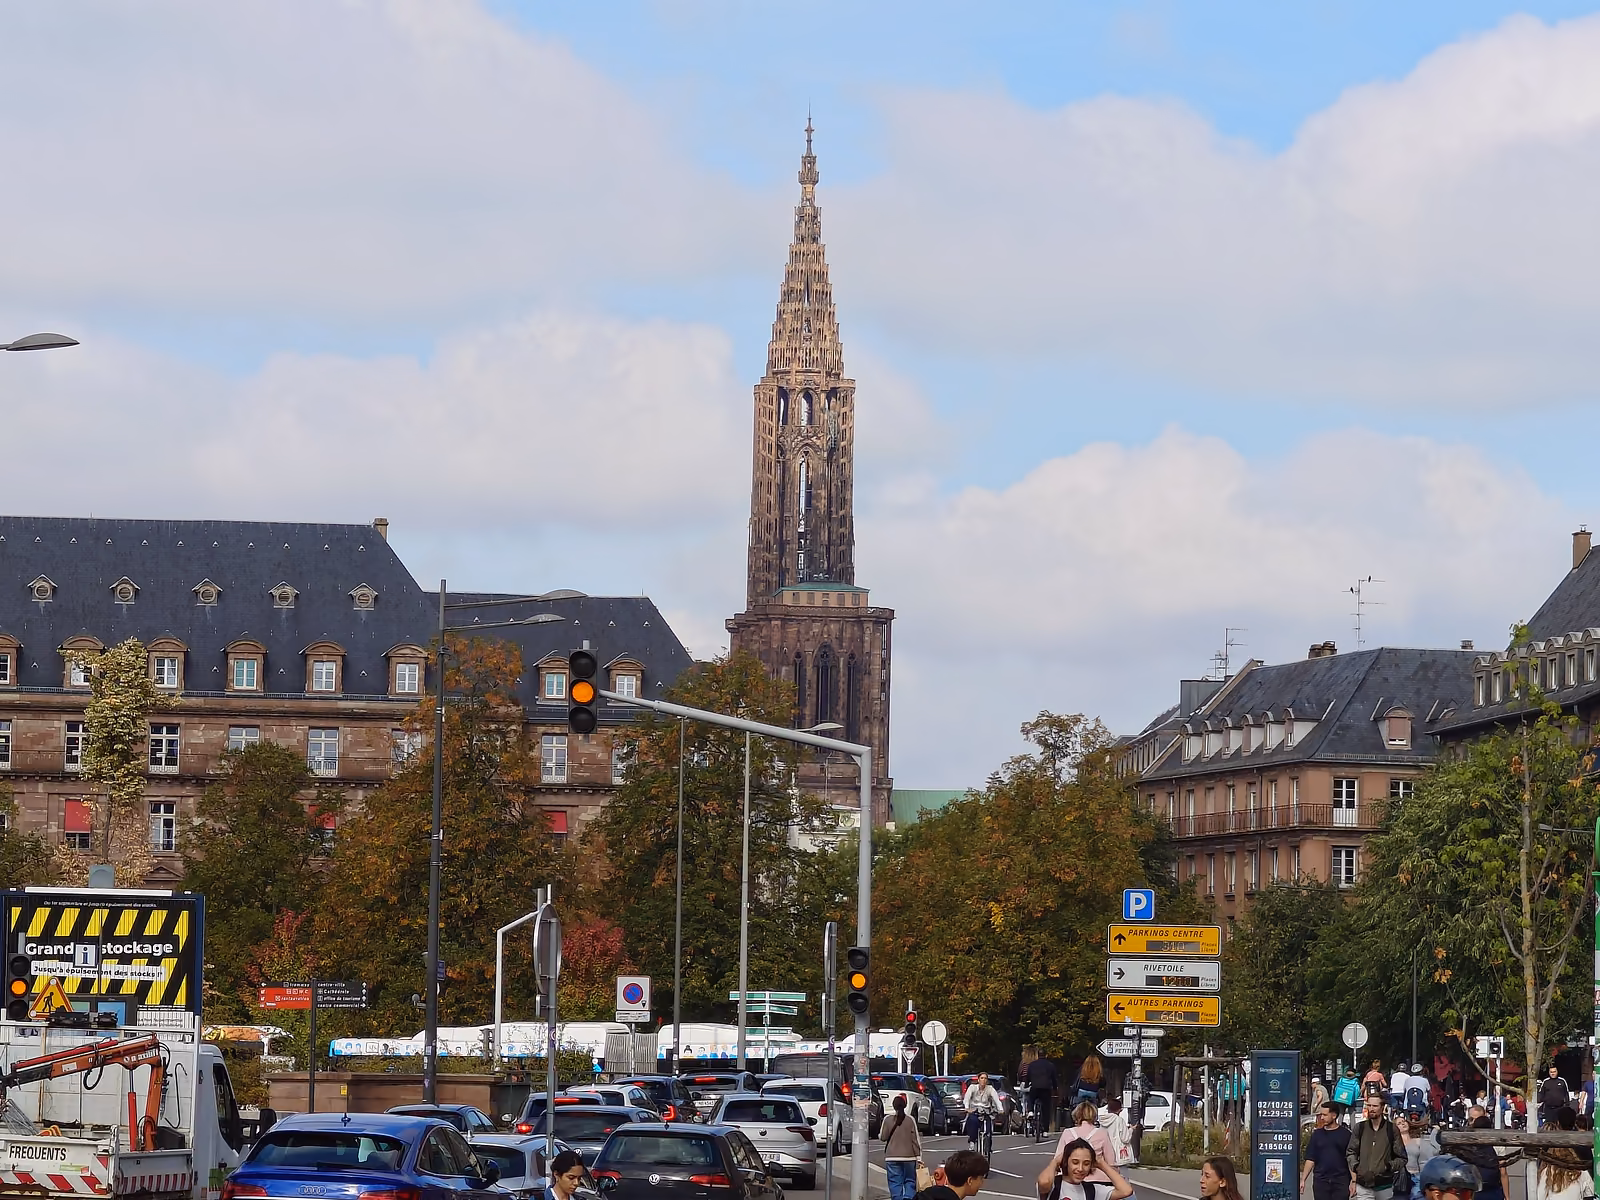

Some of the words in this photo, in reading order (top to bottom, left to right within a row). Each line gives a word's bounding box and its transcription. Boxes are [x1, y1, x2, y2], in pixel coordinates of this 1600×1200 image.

[1130, 893, 1147, 917] P
[25, 943, 74, 955] Grand
[101, 942, 173, 956] stockage
[34, 966, 63, 975] Jusqu'à
[130, 969, 155, 977] stocks
[1144, 964, 1184, 972] RIVETOILE
[1162, 1001, 1204, 1009] PARKINGS
[1161, 1012, 1184, 1022] 640
[9, 1145, 67, 1161] FREQUENTS
